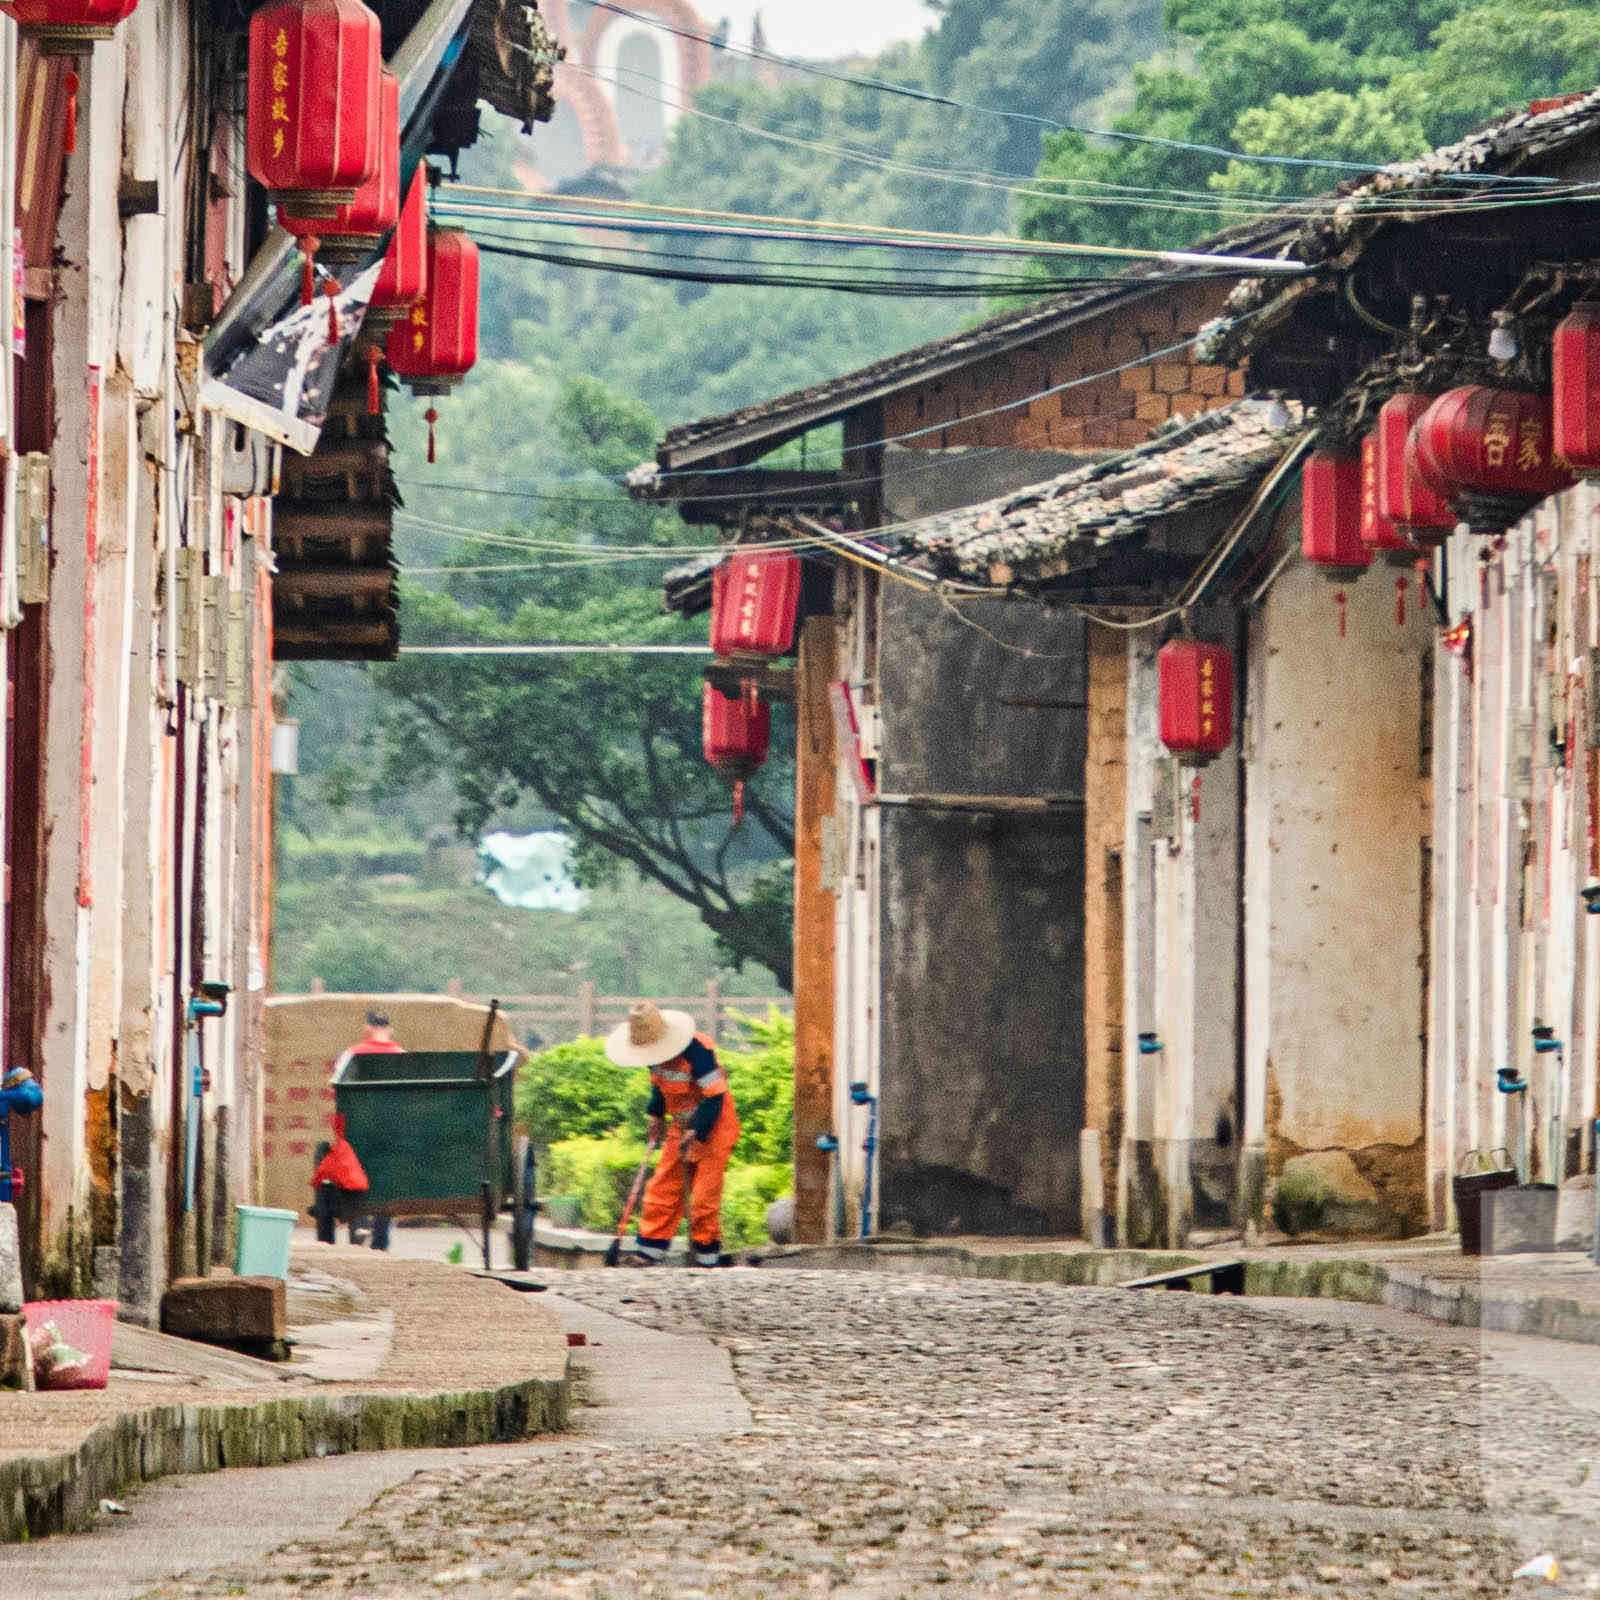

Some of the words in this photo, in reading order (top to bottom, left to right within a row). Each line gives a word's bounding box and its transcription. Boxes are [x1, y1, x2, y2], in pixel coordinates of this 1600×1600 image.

[271, 27, 291, 159] 吾家故乡
[1483, 411, 1575, 472] 吾家
